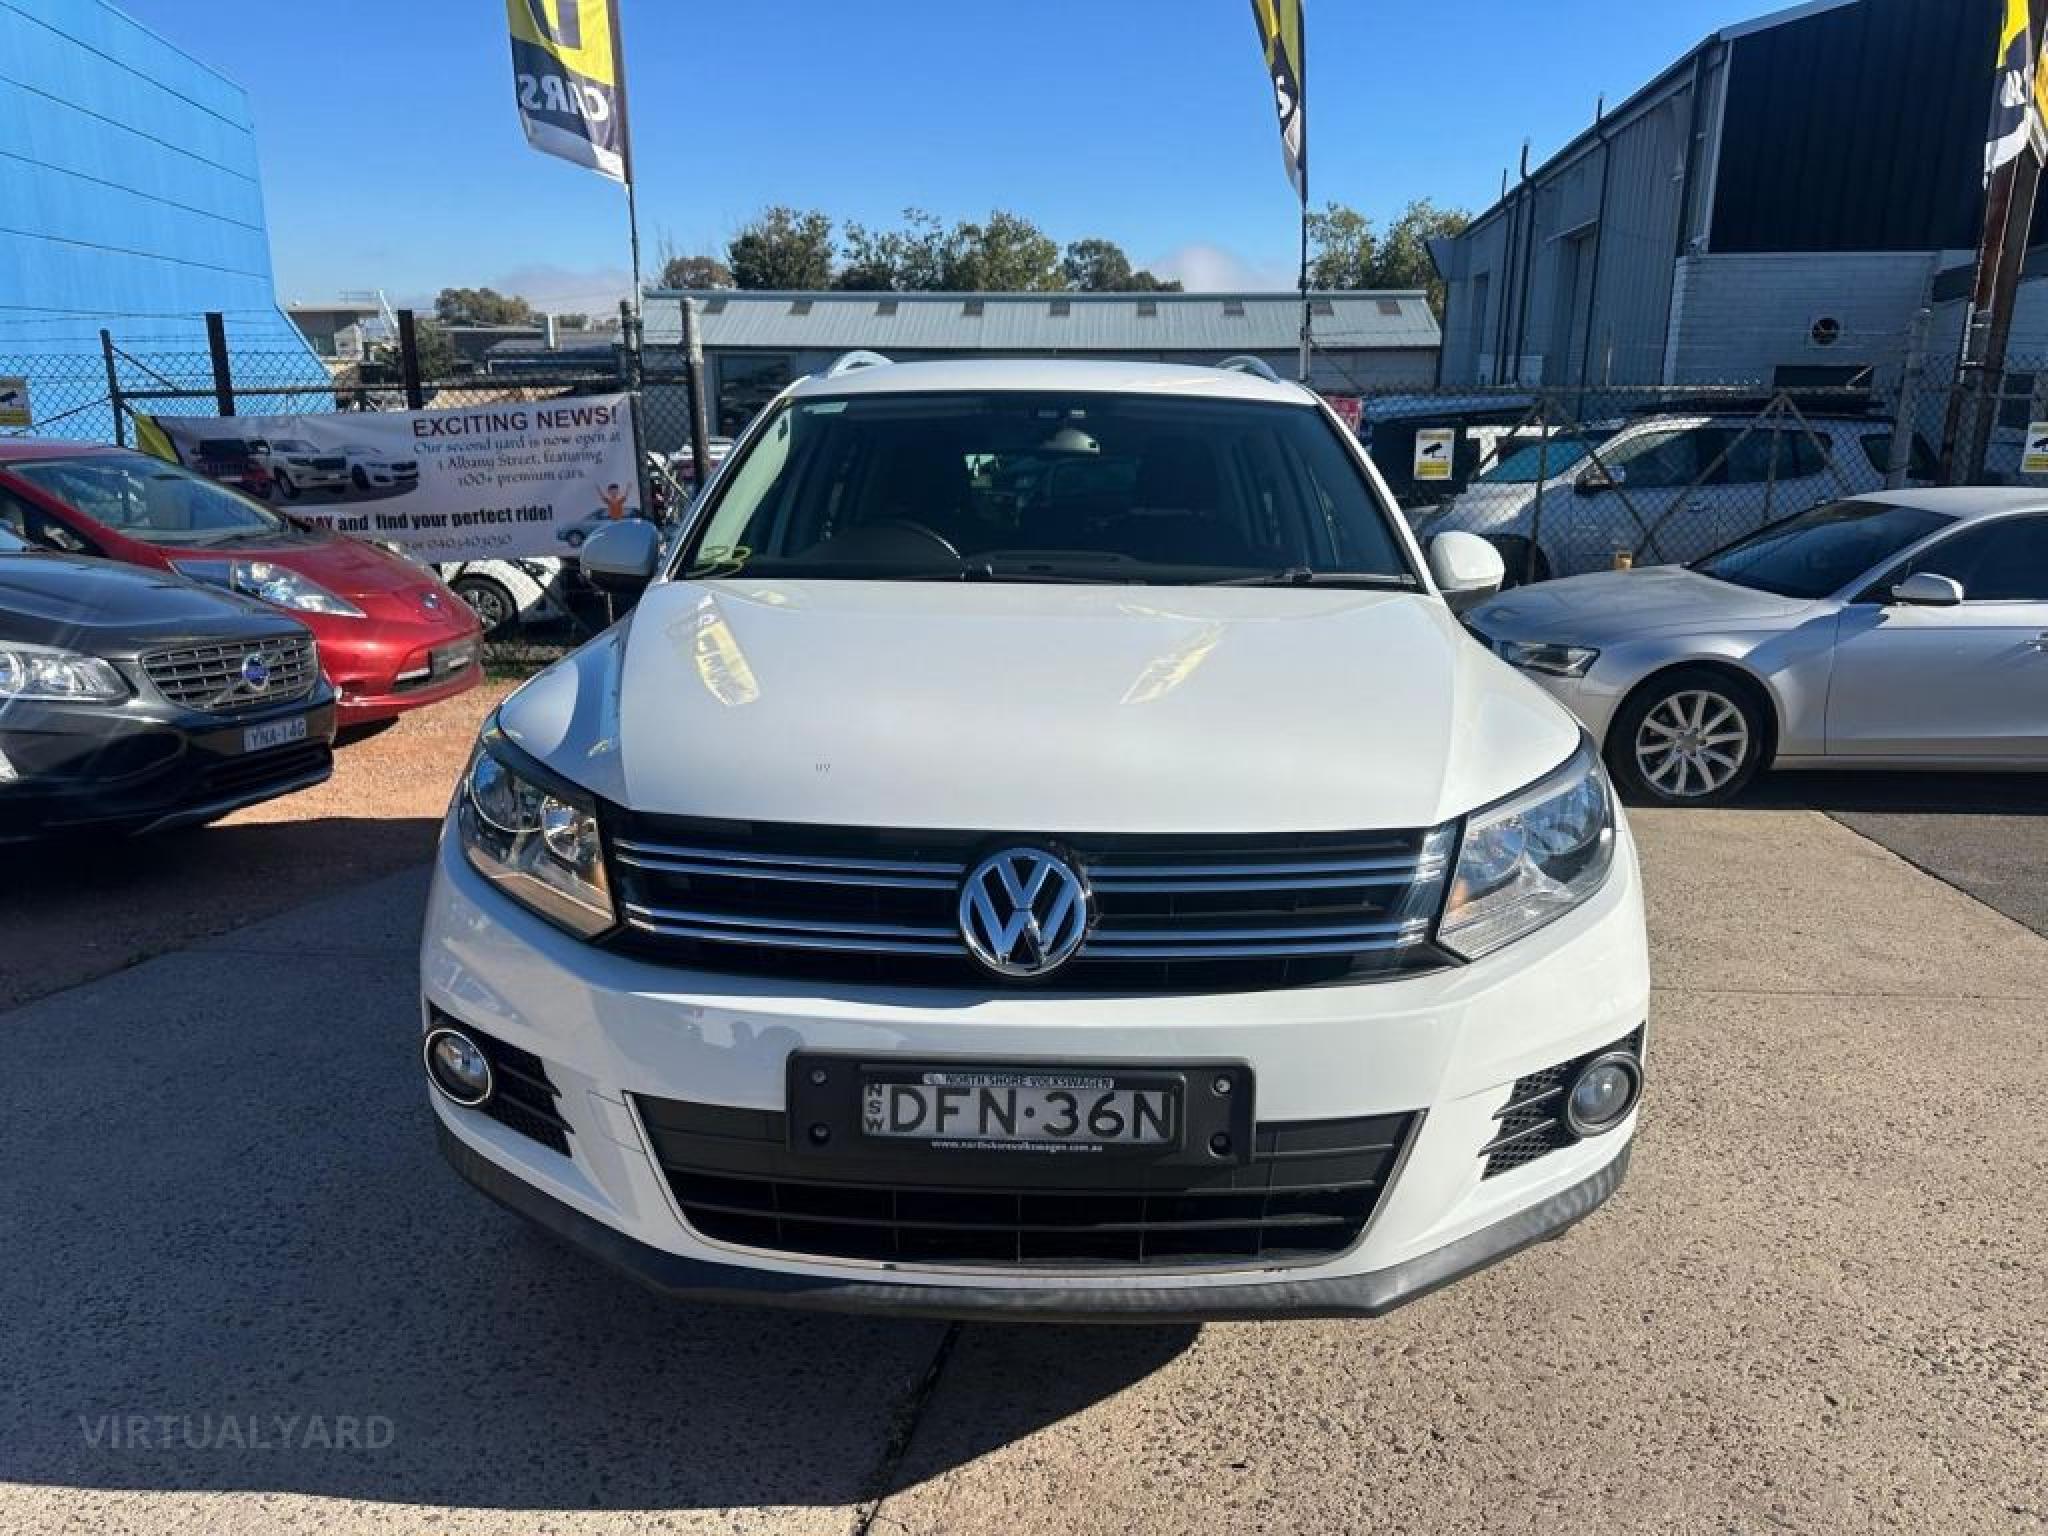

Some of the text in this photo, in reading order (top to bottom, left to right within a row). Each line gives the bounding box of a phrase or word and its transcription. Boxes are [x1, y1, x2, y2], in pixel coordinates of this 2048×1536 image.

[413, 405, 618, 437] EXCITING NEWS!
[414, 431, 621, 455] Our second yard is now open at
[448, 455, 495, 471] Albany
[497, 470, 555, 488] premium
[338, 513, 368, 531] and
[376, 511, 409, 530] find
[411, 512, 447, 531] your
[451, 506, 512, 529] perfect
[515, 504, 553, 522] ride!
